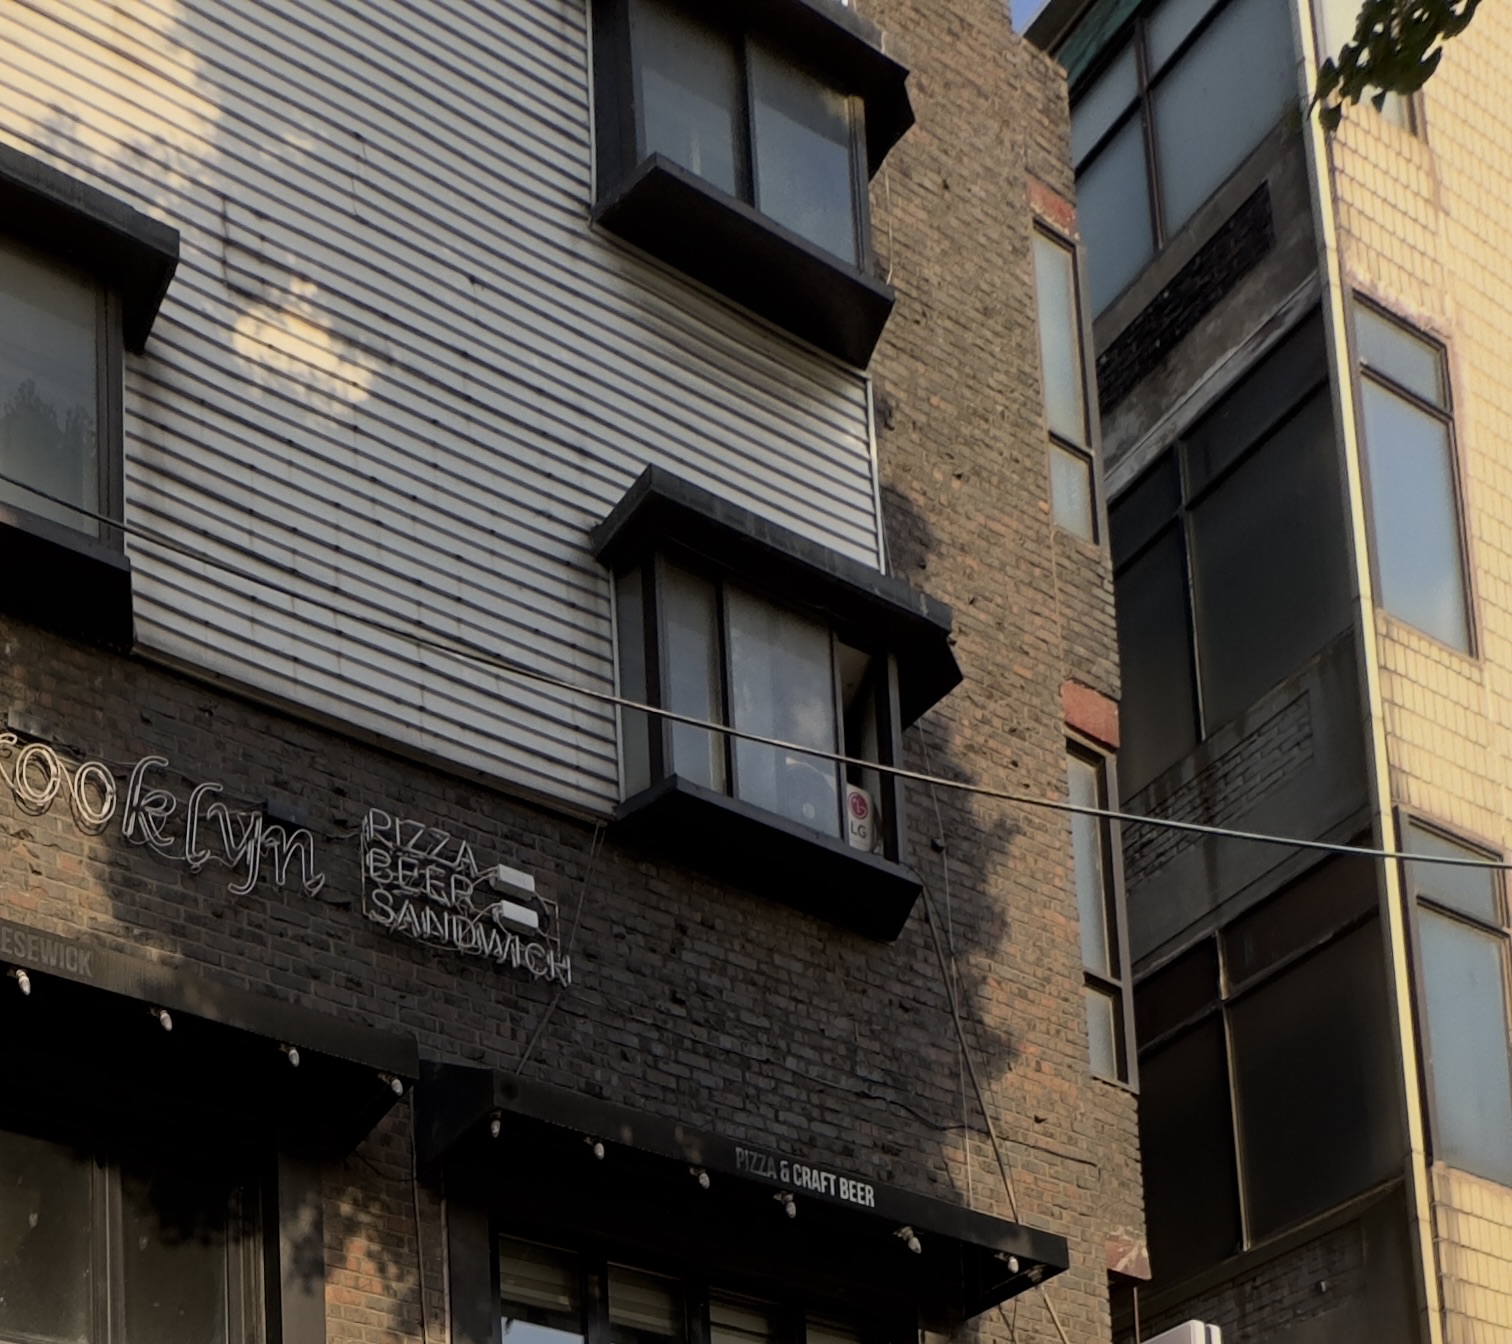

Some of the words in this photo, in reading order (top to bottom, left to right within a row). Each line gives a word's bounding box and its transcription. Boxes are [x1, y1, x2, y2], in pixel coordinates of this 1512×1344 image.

[363, 808, 479, 878] PIZZA
[366, 848, 474, 908] BEER
[368, 889, 572, 987] SANDWICH
[735, 1147, 777, 1180] PIZZA
[780, 1160, 790, 1183] &
[793, 1164, 836, 1196] CRAFT
[839, 1177, 875, 1208] BEER
